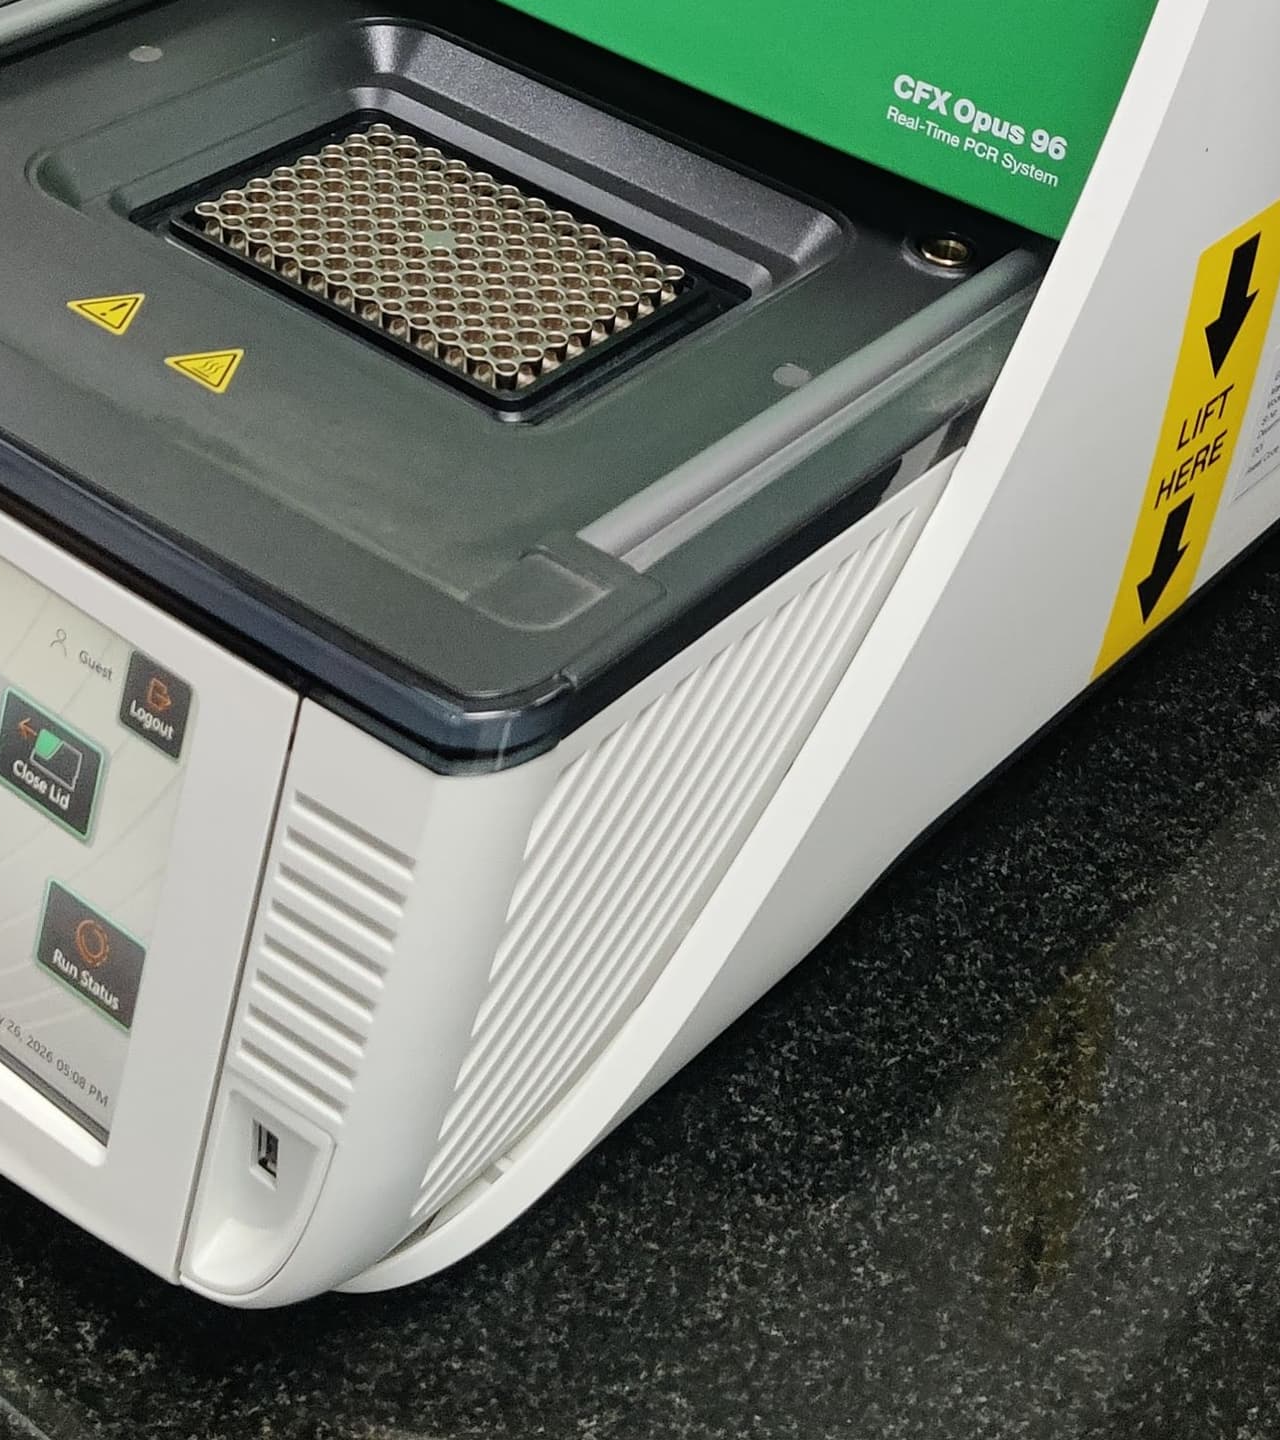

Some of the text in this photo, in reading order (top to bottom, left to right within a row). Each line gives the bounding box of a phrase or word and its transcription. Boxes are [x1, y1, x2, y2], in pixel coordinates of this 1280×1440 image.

[886, 105, 1059, 188] Real-Time PCR System
[893, 74, 1068, 161] CFX Opus 96
[1176, 383, 1235, 452] LIFT
[1153, 428, 1228, 511] HERE
[79, 650, 113, 681] Guest
[130, 699, 175, 740] Logout
[12, 759, 71, 811] Close Lid
[52, 947, 120, 1011] Run Status
[5, 1019, 23, 1043] 26,
[25, 1035, 54, 1064] 2026
[55, 1058, 87, 1091] 05:08
[87, 1083, 110, 1108] PM
